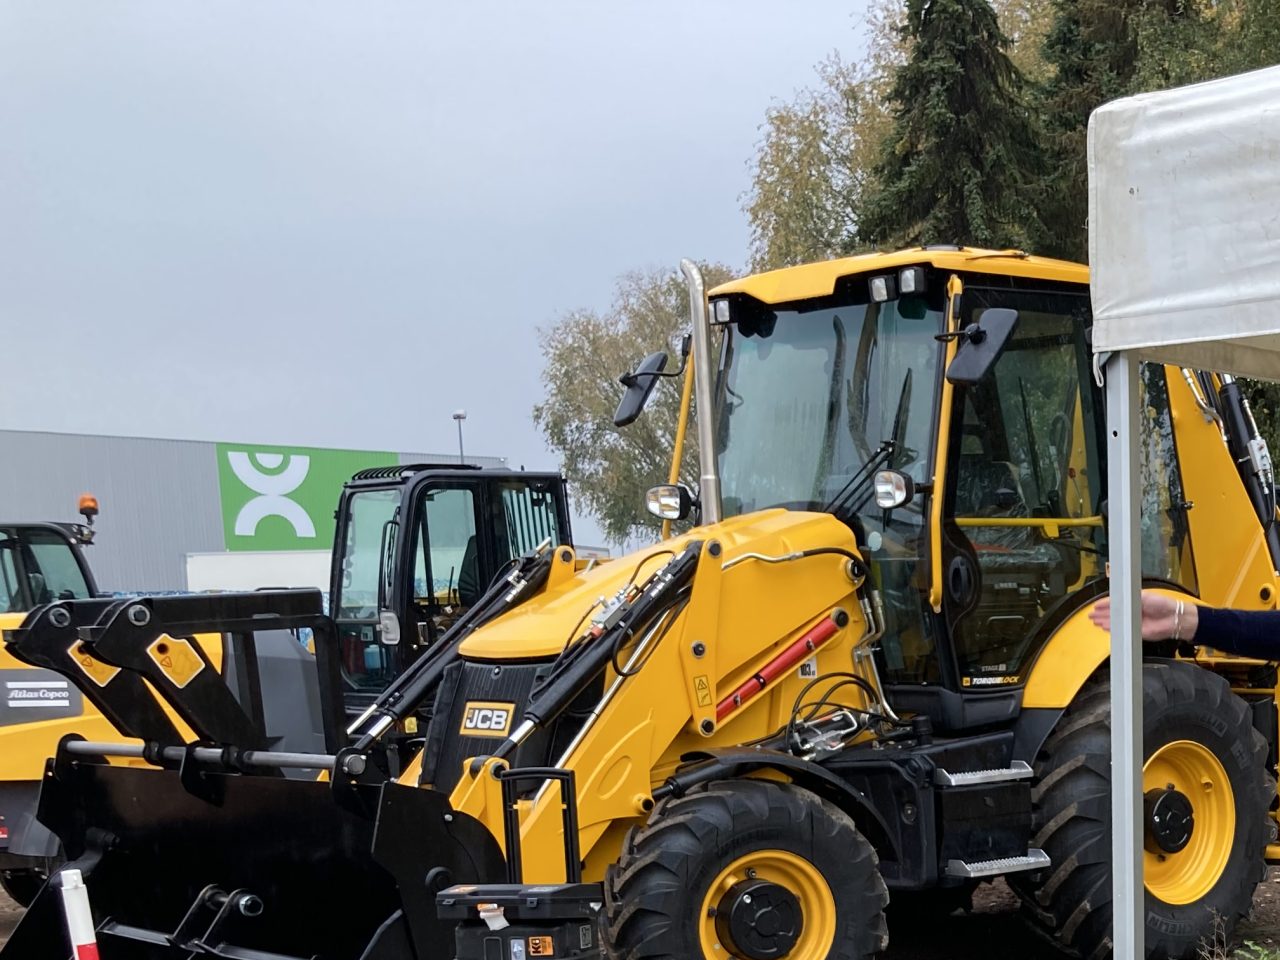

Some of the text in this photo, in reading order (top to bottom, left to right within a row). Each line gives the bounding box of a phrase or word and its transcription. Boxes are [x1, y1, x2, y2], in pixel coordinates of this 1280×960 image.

[8, 689, 69, 700] Atlas Copco
[465, 709, 508, 730] JCB
